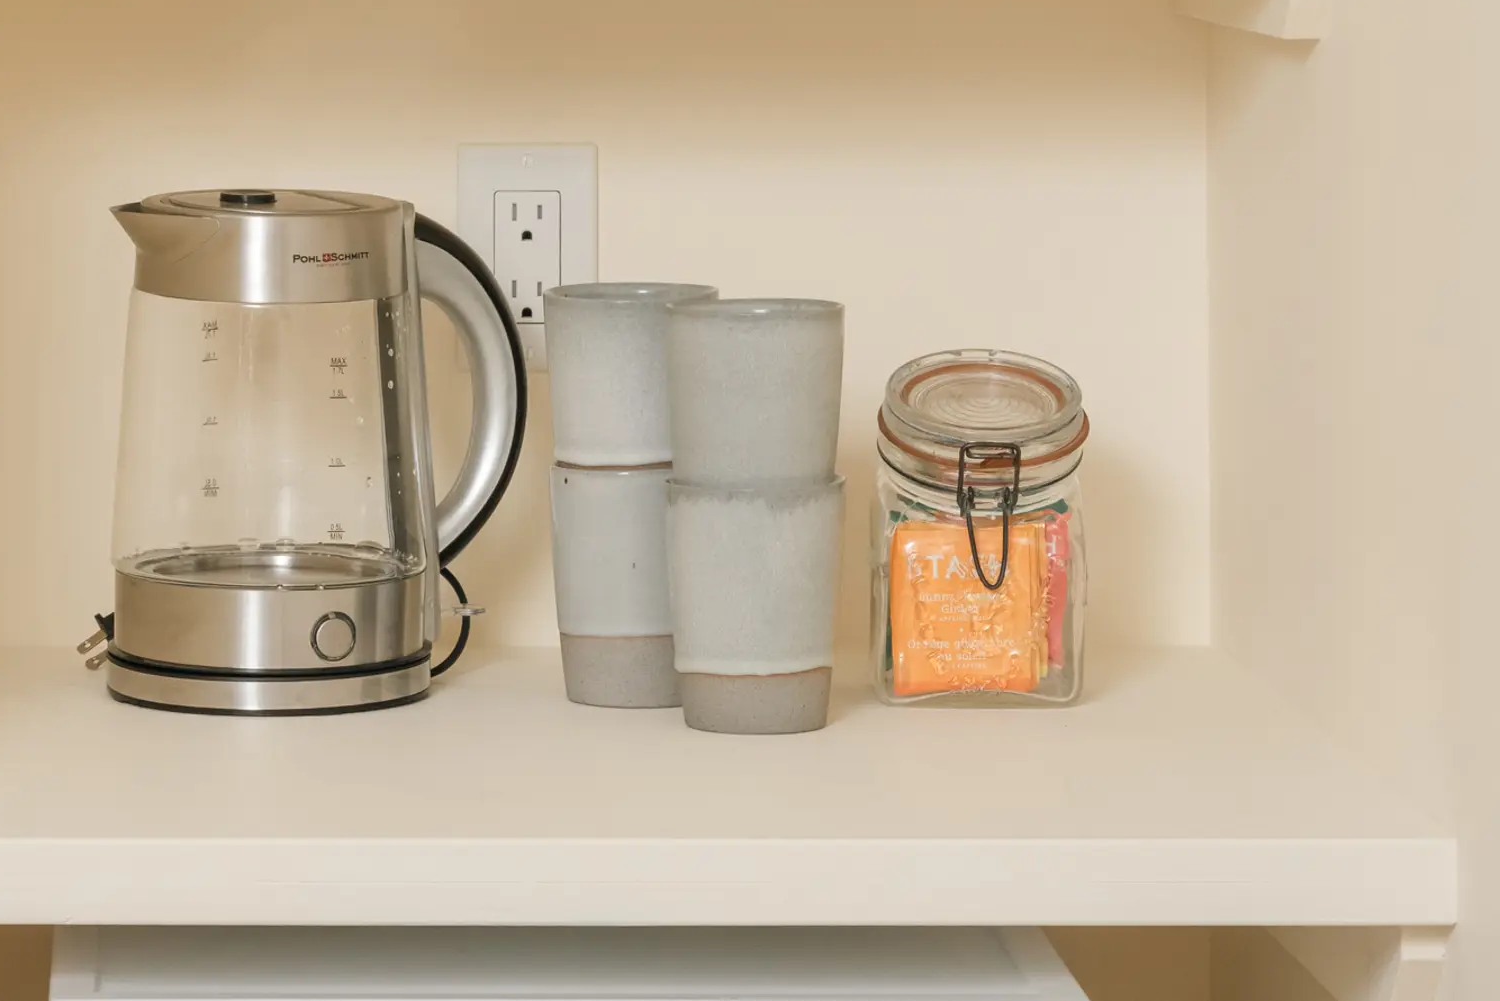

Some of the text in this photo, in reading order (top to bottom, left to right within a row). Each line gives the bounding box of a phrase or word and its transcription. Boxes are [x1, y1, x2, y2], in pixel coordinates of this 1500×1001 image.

[292, 254, 321, 263] POHL
[330, 357, 347, 365] MAX
[329, 532, 343, 541] MIN
